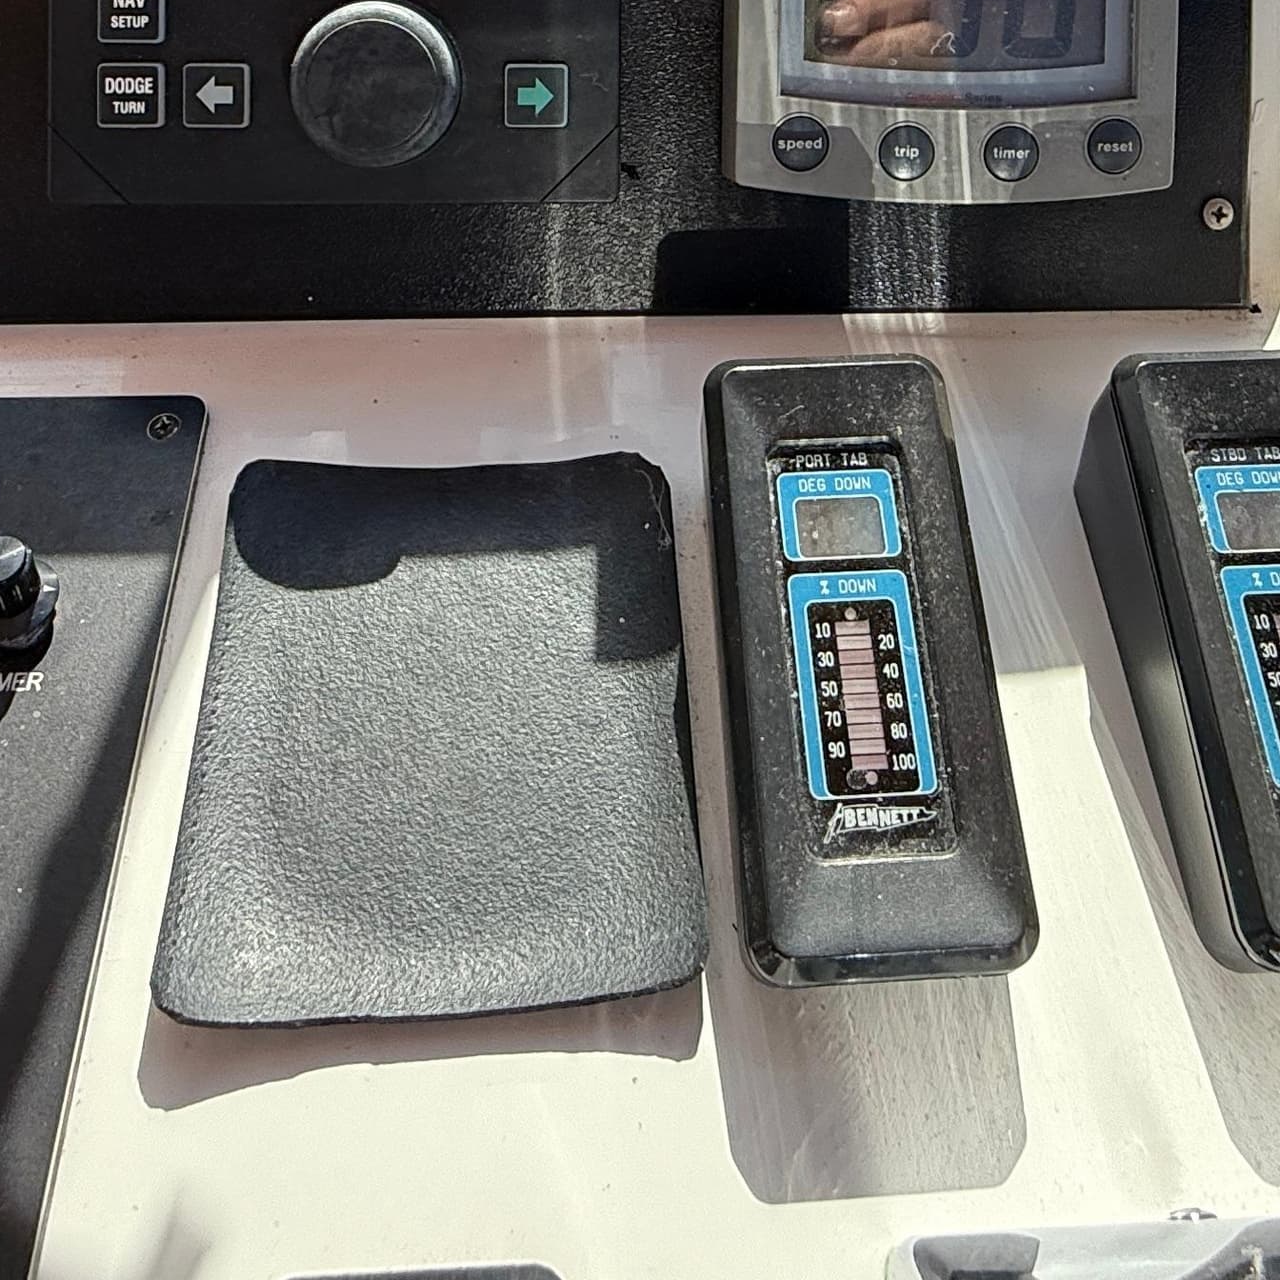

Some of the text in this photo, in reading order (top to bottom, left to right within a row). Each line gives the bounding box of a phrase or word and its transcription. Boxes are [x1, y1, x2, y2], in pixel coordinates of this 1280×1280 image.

[110, 14, 150, 29] SETUP
[104, 76, 154, 95] DODGE
[113, 100, 146, 115] TURN
[777, 135, 822, 152] speed
[1096, 139, 1134, 153] reset
[893, 143, 920, 161] trip
[992, 145, 1031, 160] timer
[795, 452, 868, 469] PORT TAB
[1210, 447, 1247, 463] STBD
[799, 476, 872, 493] DEG DOWN
[1216, 472, 1245, 486] DEG
[839, 578, 876, 593] DOWN
[1254, 613, 1270, 630] 10
[815, 622, 831, 639] 10
[878, 634, 895, 651] 20
[1260, 642, 1277, 658] 30
[817, 651, 834, 667] 30
[882, 663, 899, 679] 40
[821, 681, 838, 697] 50
[886, 693, 903, 709] 60
[824, 711, 842, 727] 70
[890, 723, 907, 740] 80
[828, 742, 846, 759] 90
[892, 754, 916, 771] 100
[843, 806, 923, 829] BENNETT
